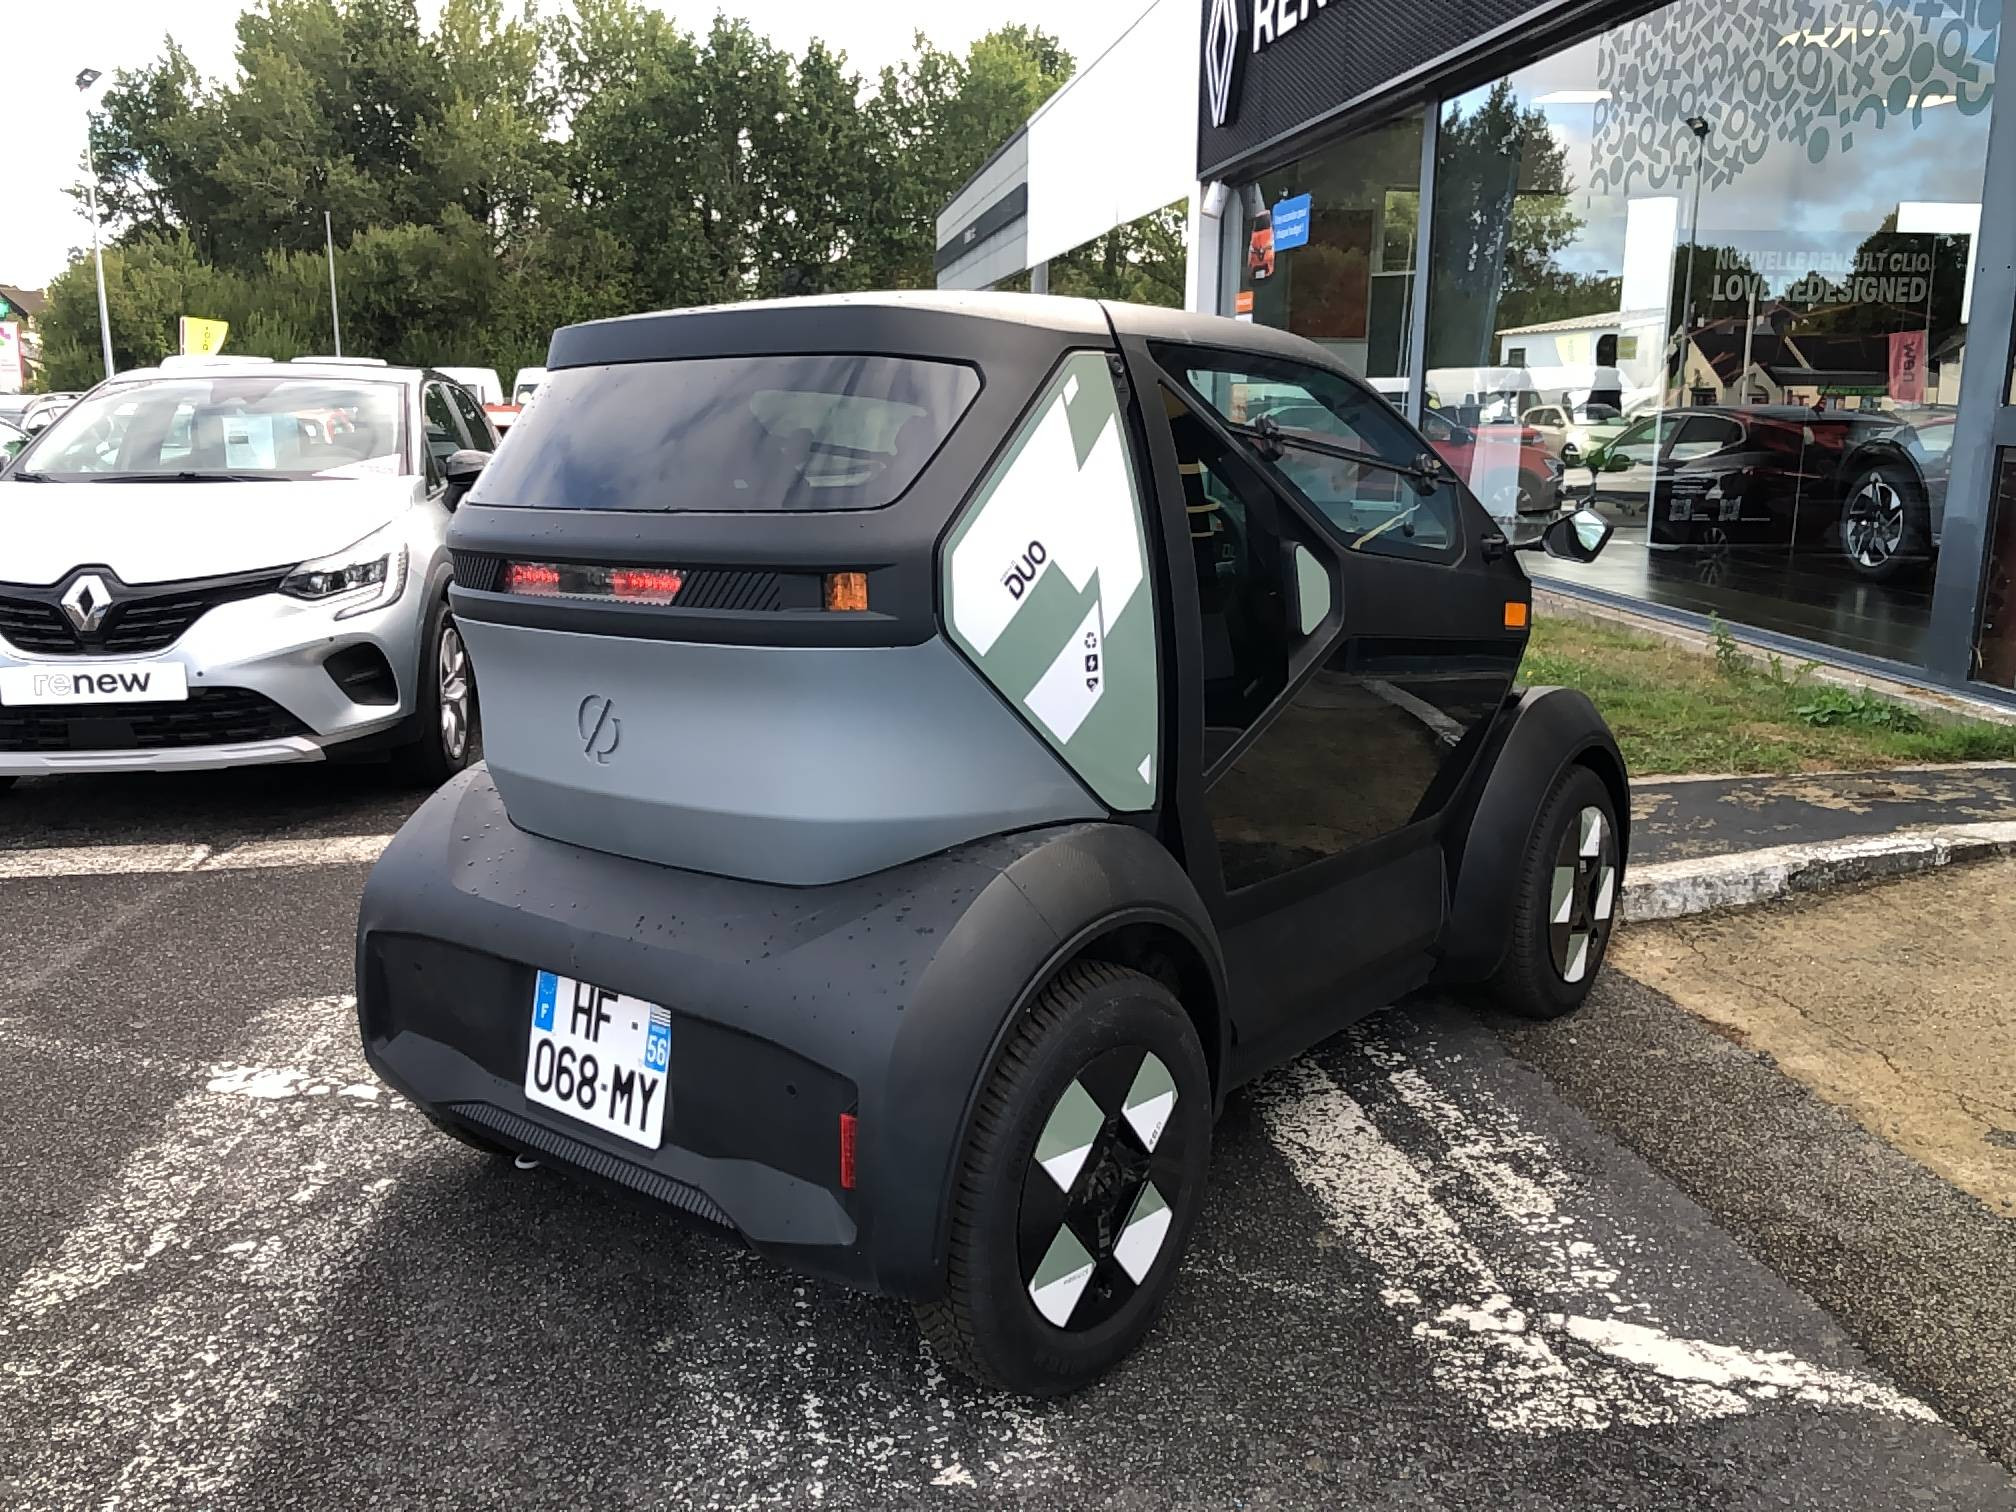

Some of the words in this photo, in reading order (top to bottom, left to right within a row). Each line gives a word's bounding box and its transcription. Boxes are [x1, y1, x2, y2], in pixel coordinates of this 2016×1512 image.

[1252, 0, 1328, 54] RE
[1889, 252, 1931, 273] CLIO
[1004, 540, 1046, 600] DUO
[34, 672, 151, 696] renew
[541, 1003, 549, 1019] F
[647, 1034, 668, 1067] 56
[534, 1038, 659, 1132] 068-MY
